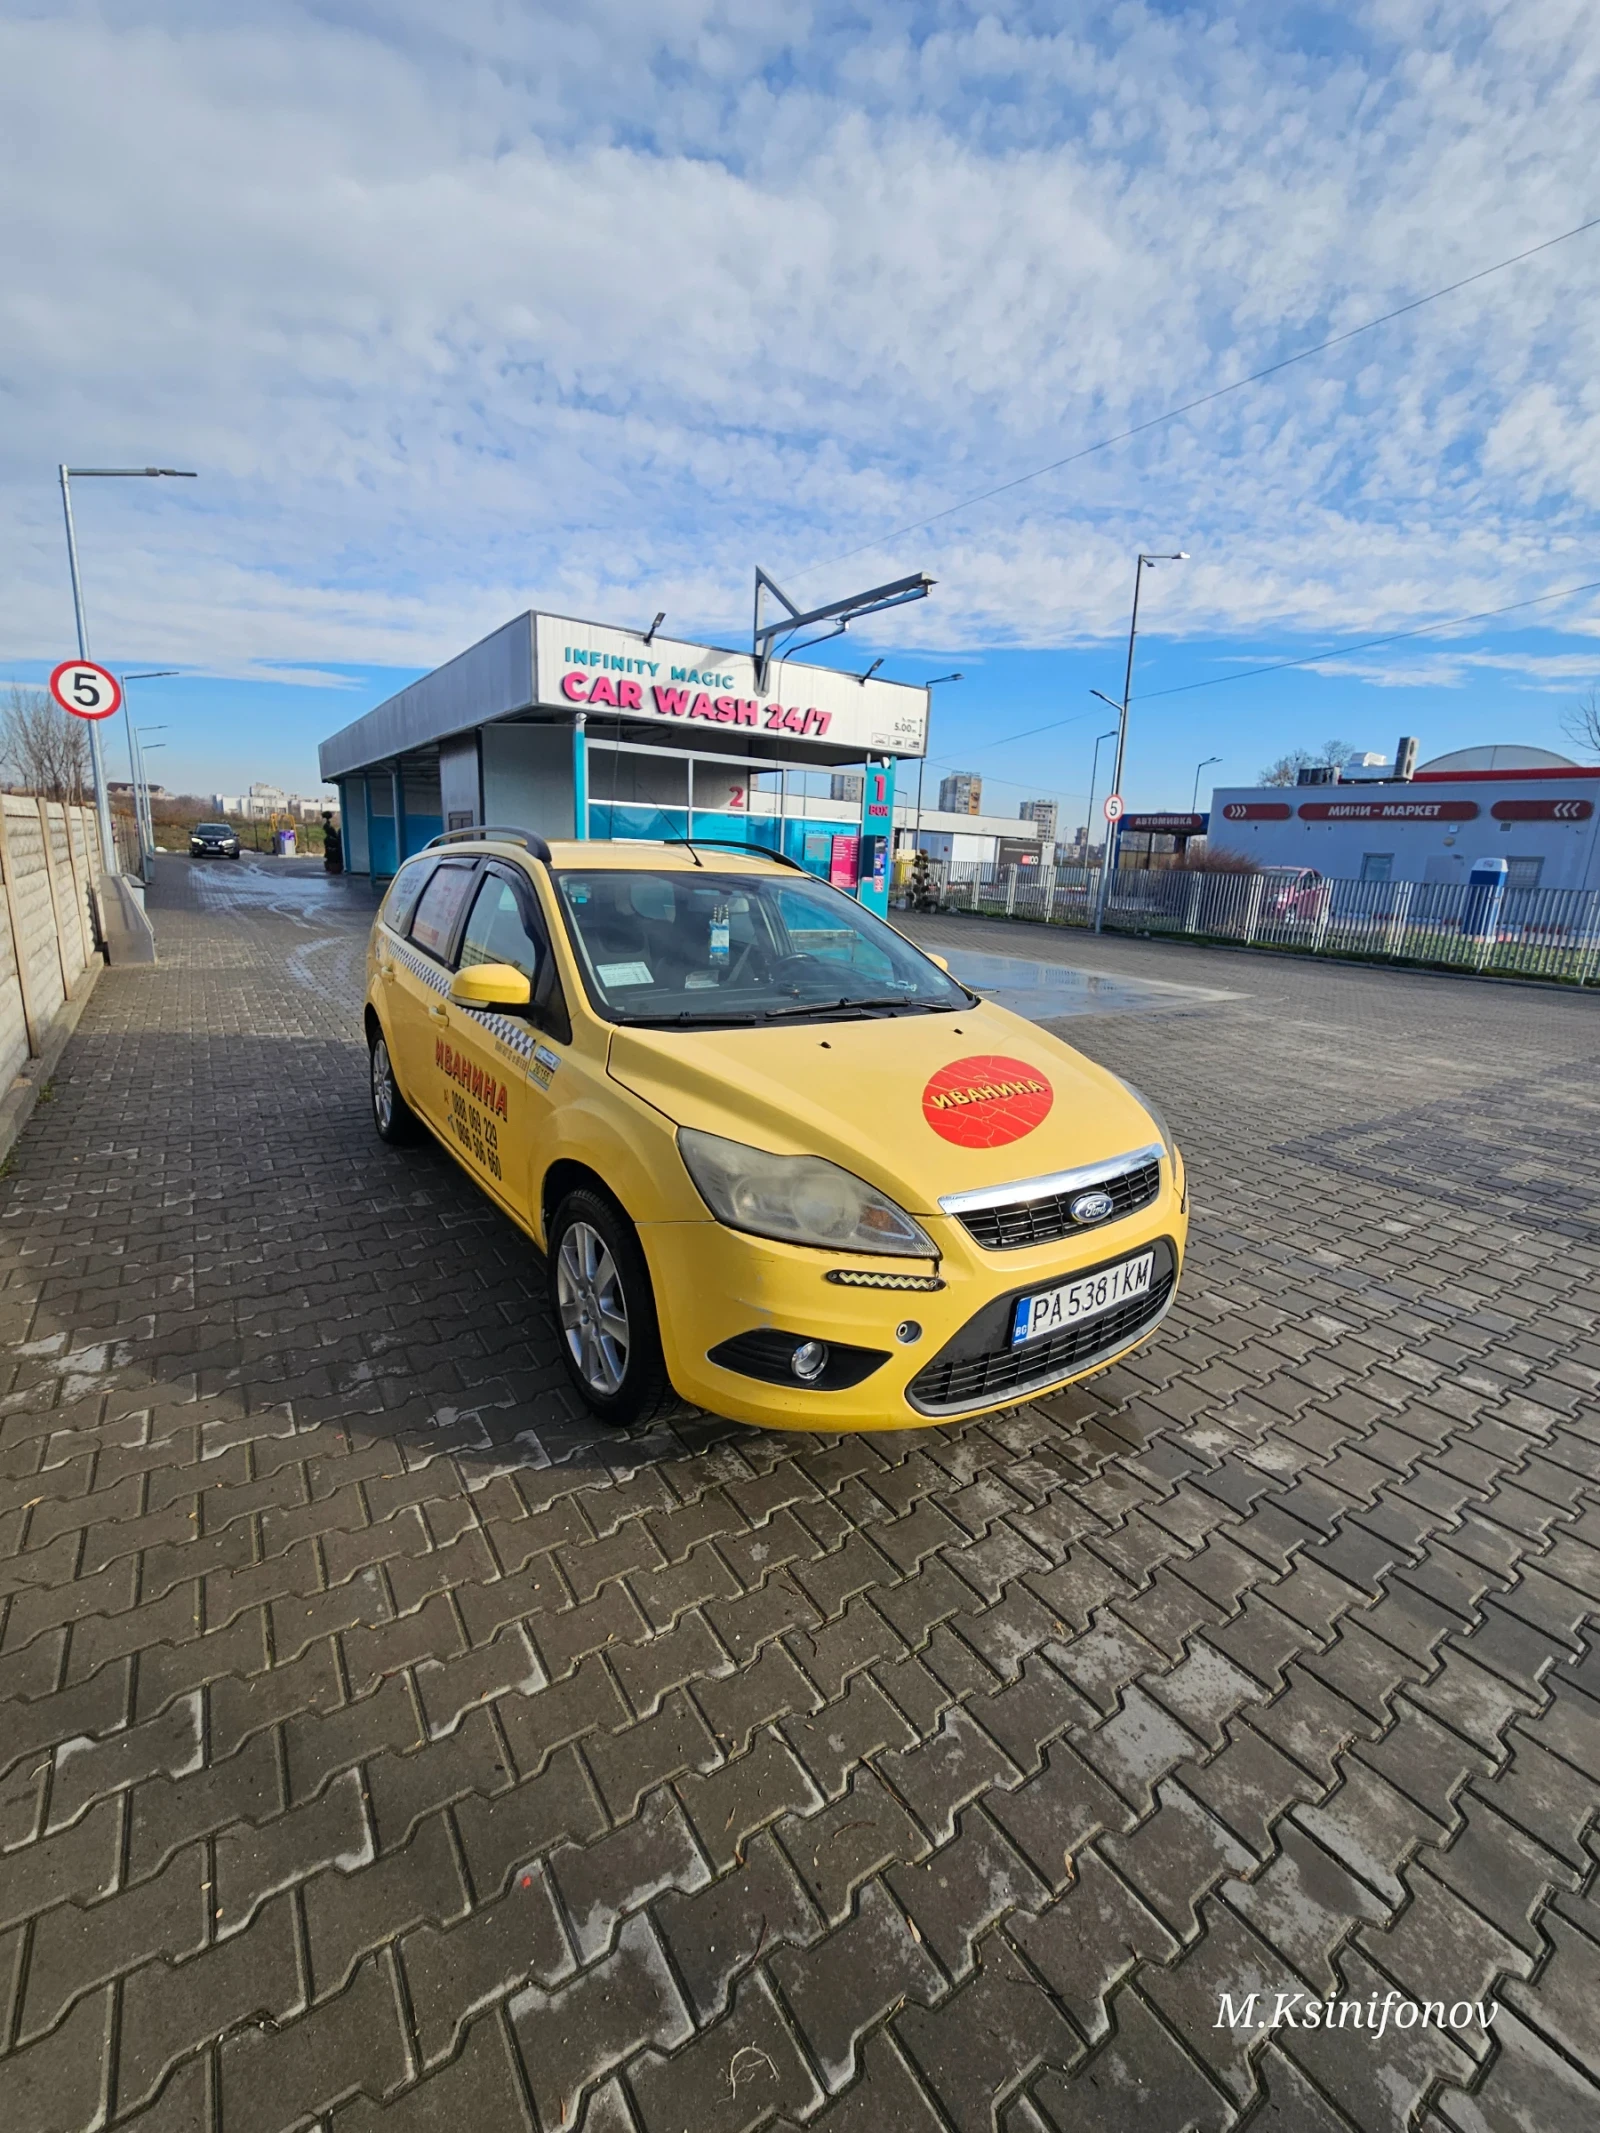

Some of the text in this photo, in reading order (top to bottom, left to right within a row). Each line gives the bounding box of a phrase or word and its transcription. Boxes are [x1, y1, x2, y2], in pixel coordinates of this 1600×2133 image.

[565, 646, 734, 690] INFINITY MAGIC
[73, 672, 100, 707] 5
[561, 671, 832, 736] CAR WASH 24/7
[729, 785, 744, 807] 2
[874, 775, 886, 802] 1
[869, 804, 889, 817] BOX
[1109, 800, 1118, 816] 5
[1135, 815, 1193, 826] АВТОМИВКА
[1328, 805, 1371, 816] МИНИ
[1383, 804, 1442, 816] МАРКЕТ
[435, 1036, 508, 1123] ИВАНИНА
[931, 1080, 1047, 1109] ИВАНИНА
[484, 1117, 497, 1150] 229
[1085, 1201, 1107, 1218] Ford
[1032, 1259, 1150, 1332] PA 5381 KM
[1015, 1324, 1027, 1337] BG
